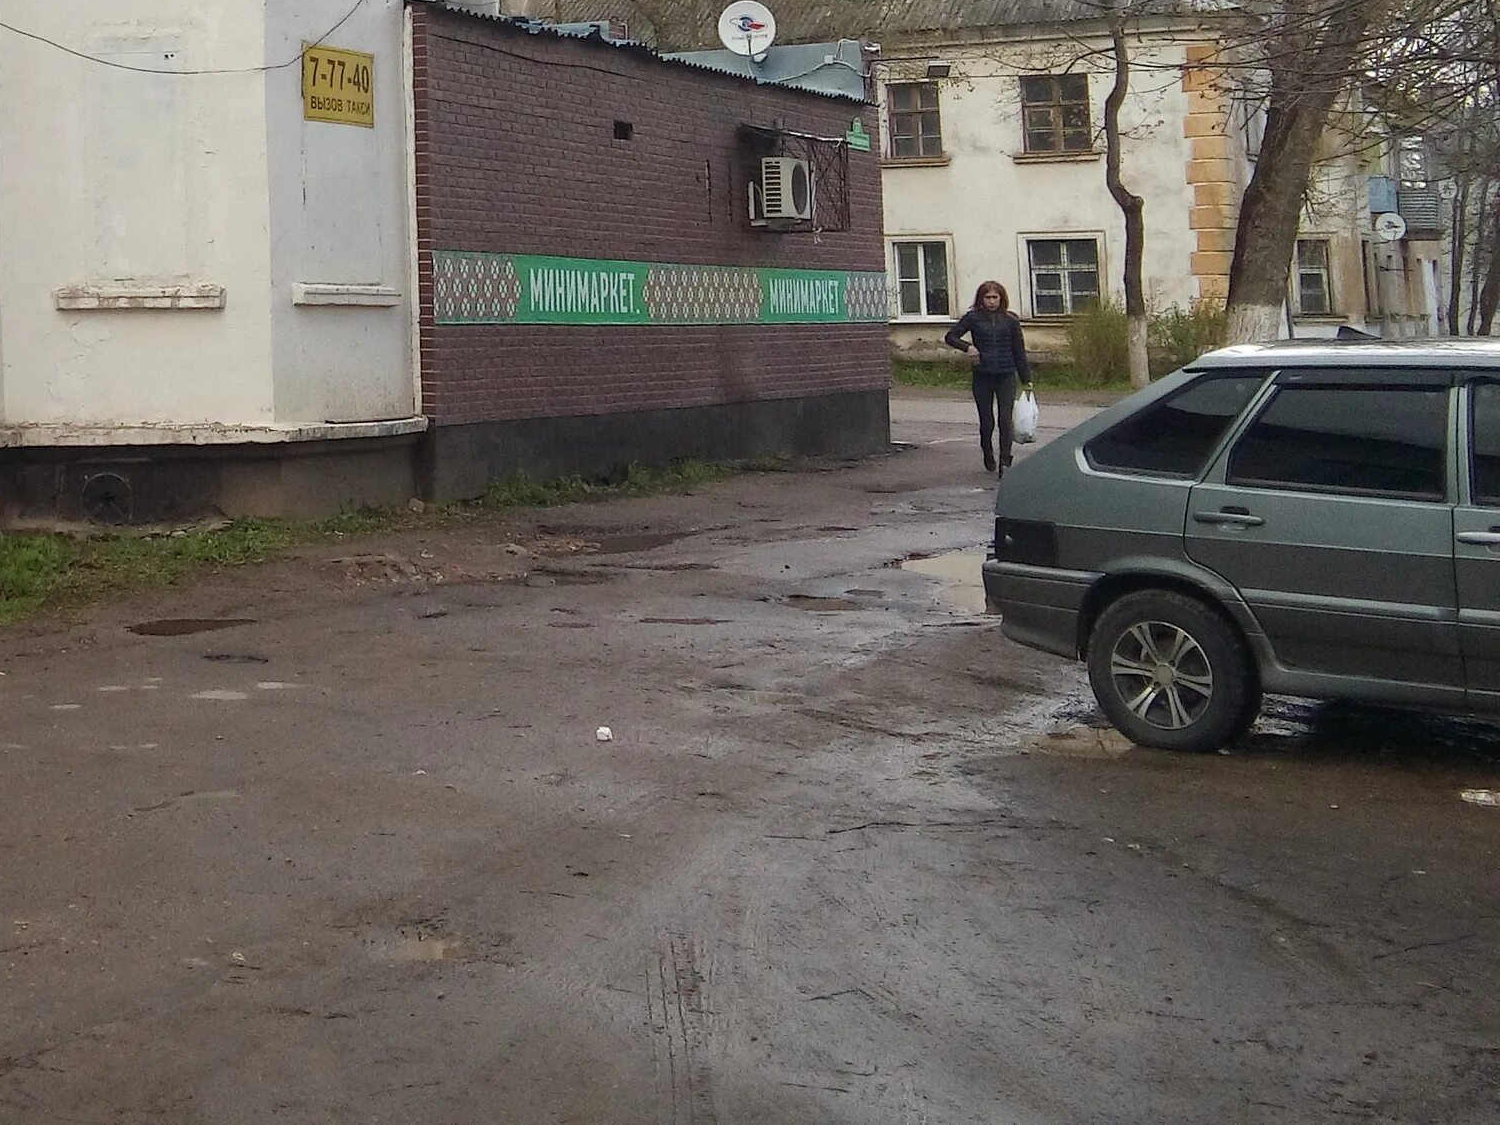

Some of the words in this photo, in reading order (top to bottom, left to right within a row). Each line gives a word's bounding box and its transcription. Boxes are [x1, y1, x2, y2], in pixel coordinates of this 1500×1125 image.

[309, 56, 369, 93] 7-77-40
[310, 95, 343, 112] ВЫЗОВ
[346, 99, 370, 116] ТАКСИ
[769, 278, 838, 314] МИНИМАРКЕТ
